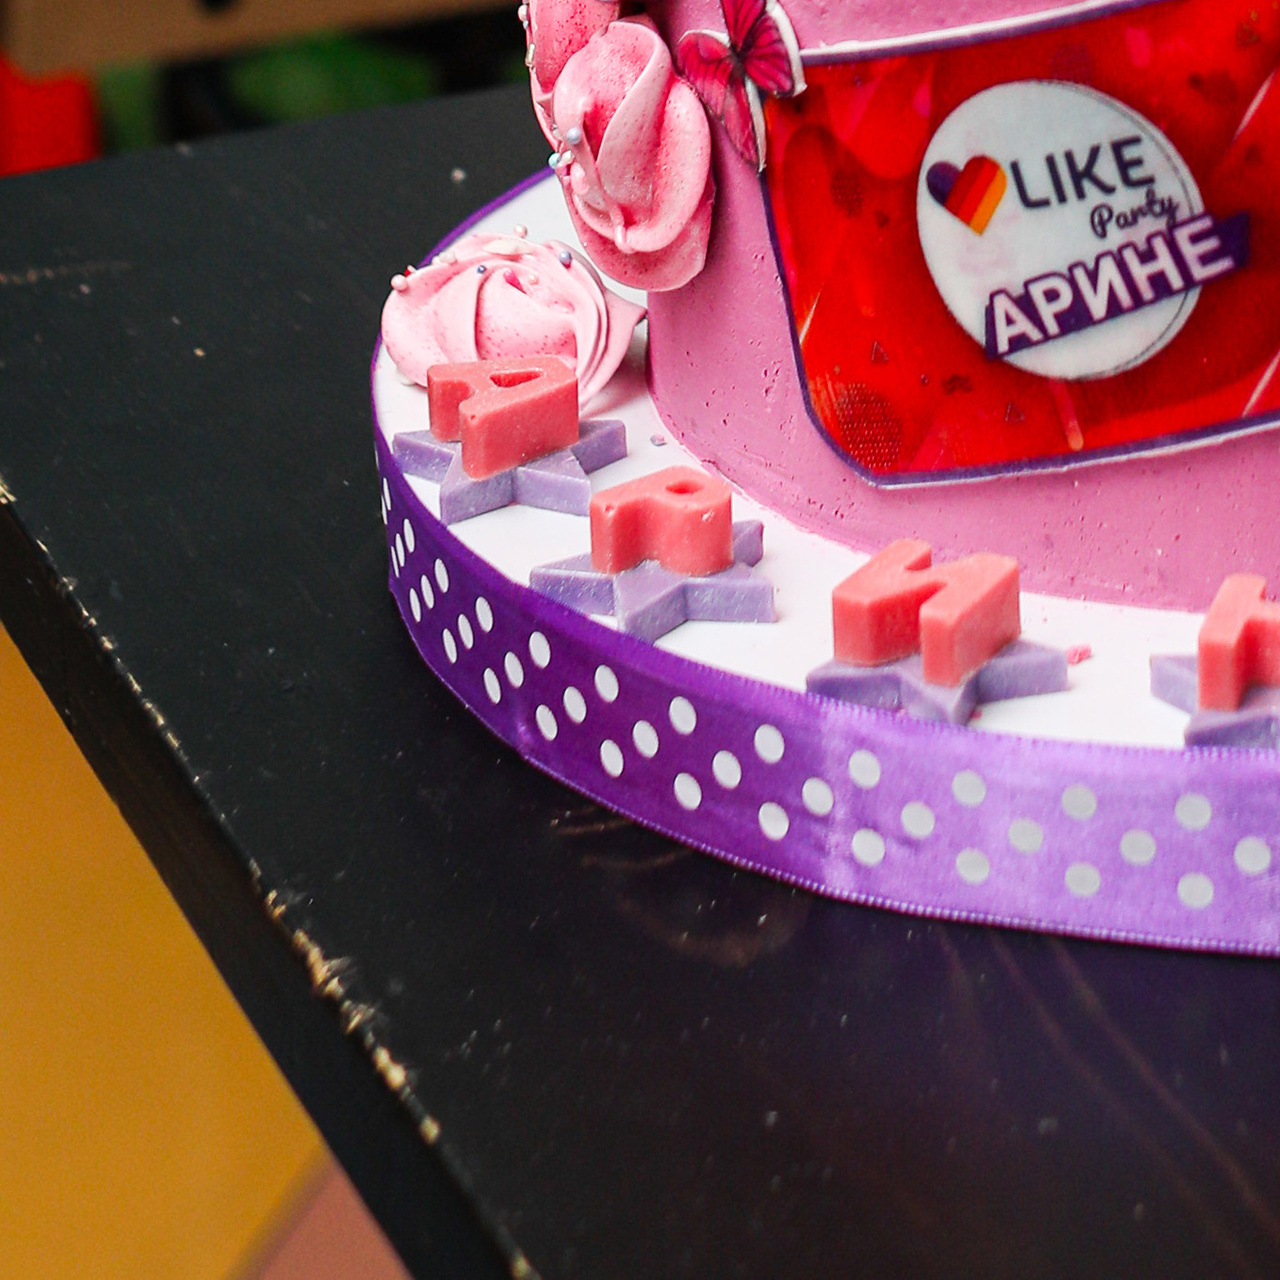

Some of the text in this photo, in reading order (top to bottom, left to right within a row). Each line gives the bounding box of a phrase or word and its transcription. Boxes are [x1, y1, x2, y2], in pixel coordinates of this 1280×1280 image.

[1009, 135, 1156, 210] LIKE
[1090, 187, 1178, 239] Party
[990, 213, 1238, 358] АРИНЕ
